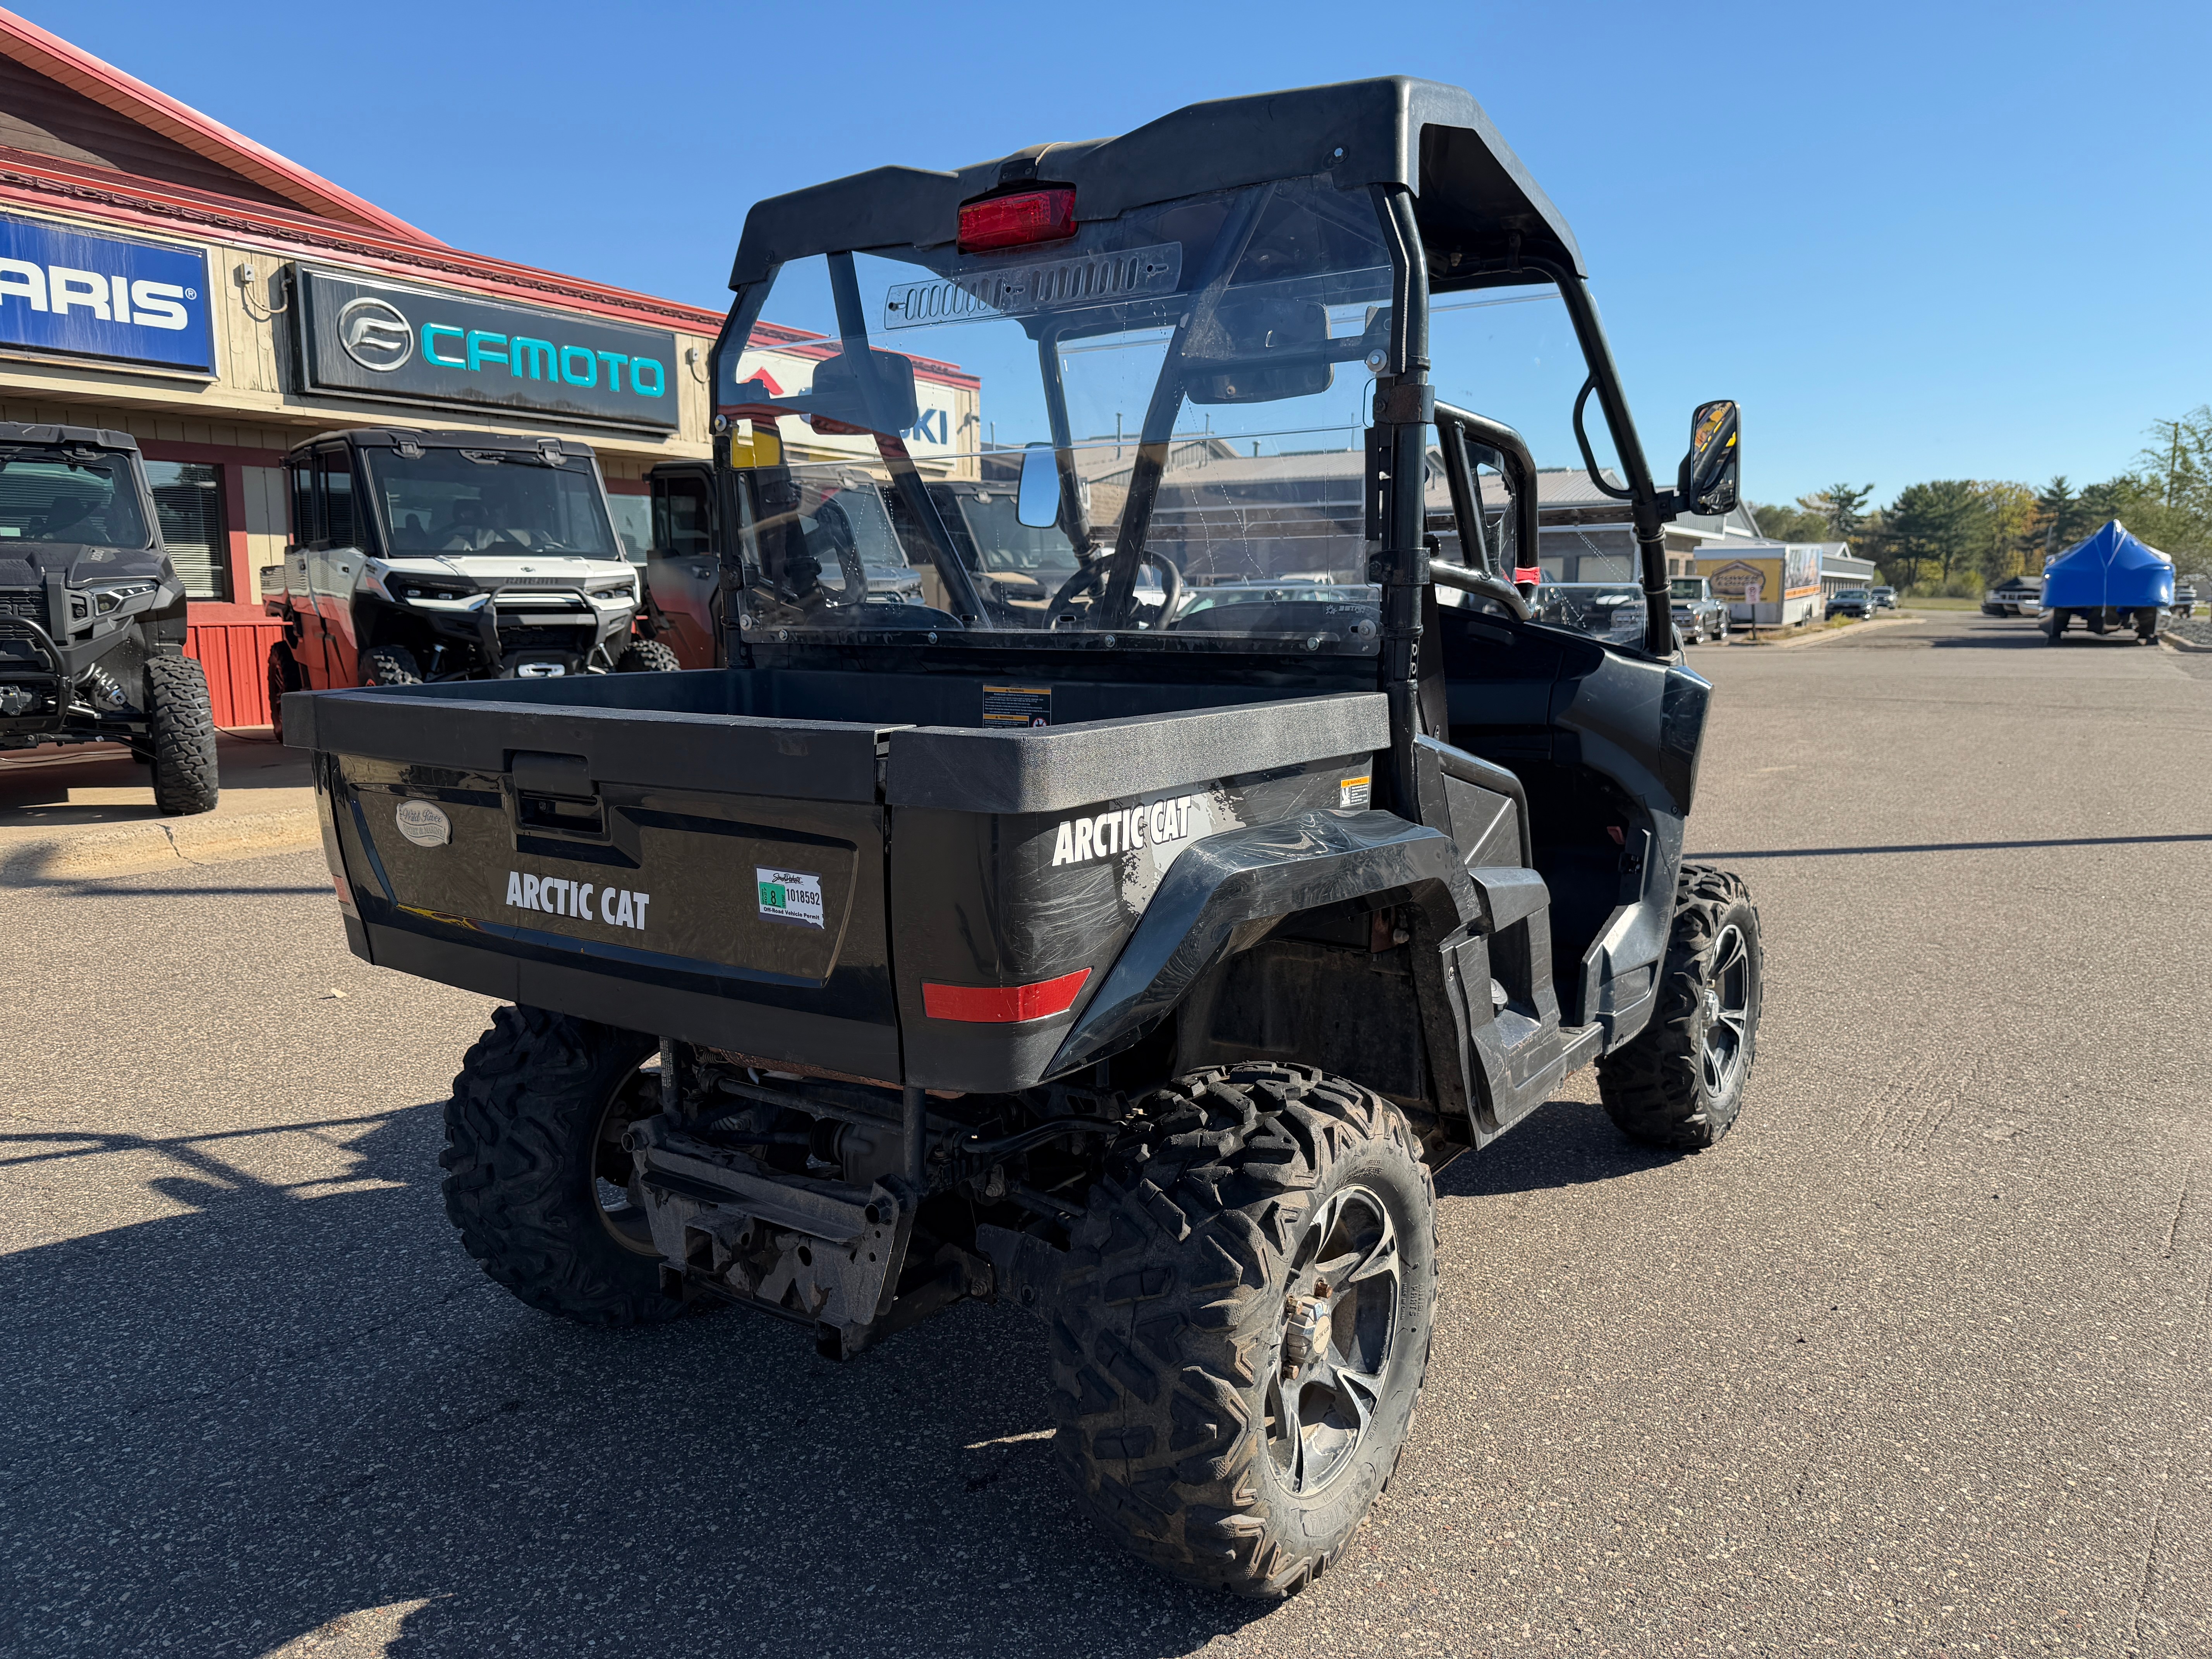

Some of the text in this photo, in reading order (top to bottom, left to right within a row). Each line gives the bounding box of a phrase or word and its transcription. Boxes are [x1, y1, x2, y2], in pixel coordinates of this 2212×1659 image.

[421, 323, 665, 397] CFMOTO
[403, 808, 443, 823] Wild River
[403, 824, 418, 835] SPORT
[1052, 794, 1191, 866] ARCTIC CAT
[506, 871, 649, 930] ARCTIC CAT
[771, 890, 776, 905] 8
[787, 889, 820, 905] 1018592
